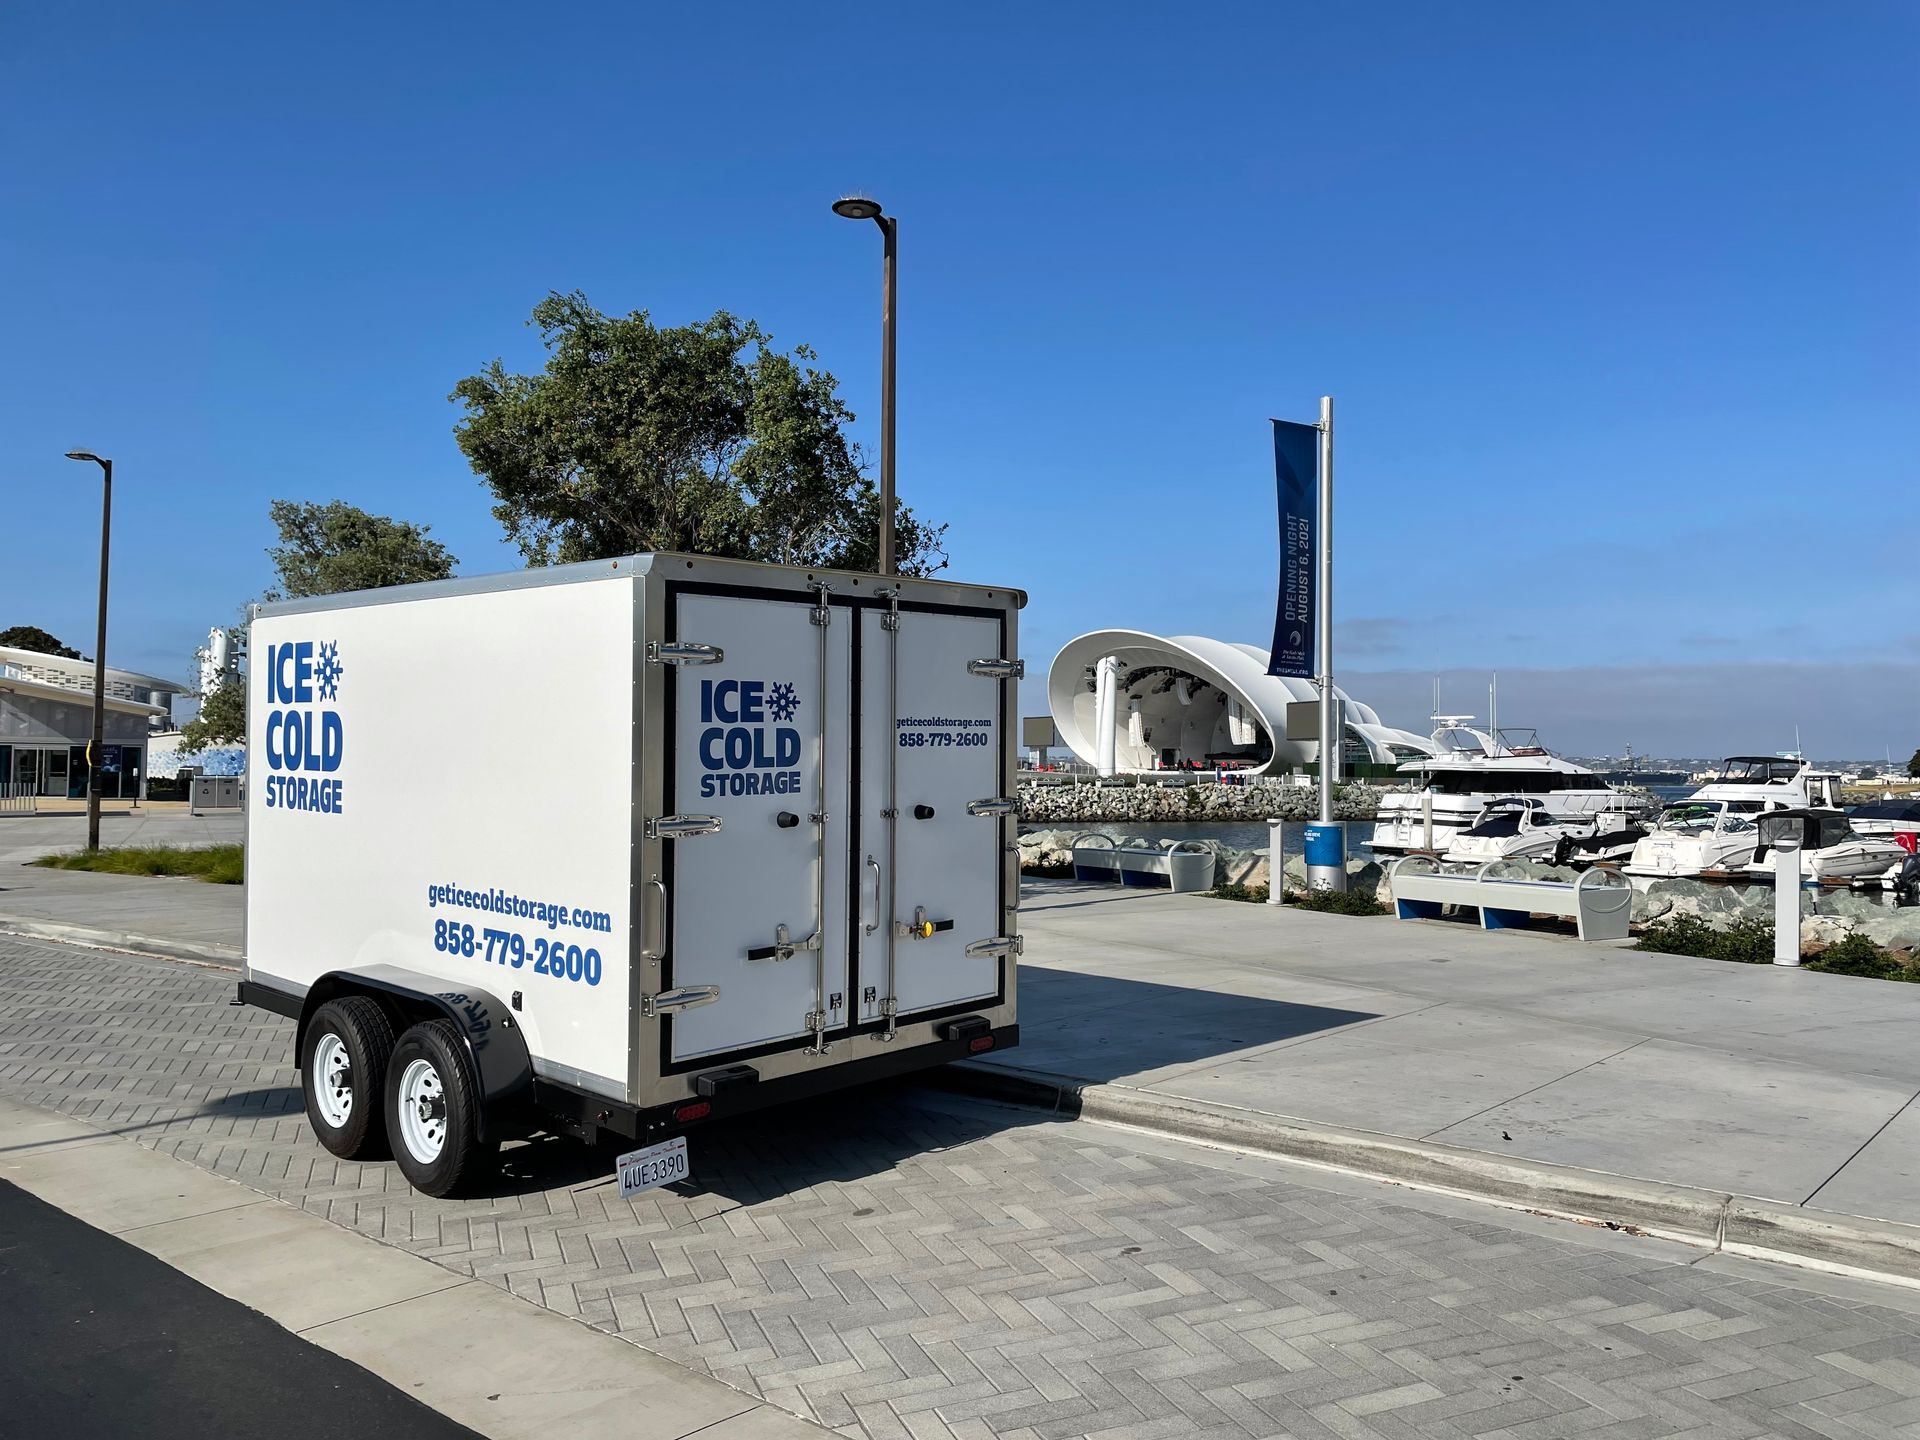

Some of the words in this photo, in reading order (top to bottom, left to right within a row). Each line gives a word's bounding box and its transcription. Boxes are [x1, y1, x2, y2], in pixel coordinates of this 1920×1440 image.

[1287, 512, 1297, 555] NIGHT
[1299, 518, 1309, 549] 2021
[1299, 553, 1310, 566] 6,
[1285, 559, 1297, 621] OPENING
[1298, 567, 1309, 623] AUGUST
[267, 641, 313, 704] ICE
[700, 679, 764, 724] ICE
[896, 716, 992, 729] geticecoldstorage.com
[266, 710, 343, 772] COLD
[699, 727, 802, 771] COLD
[899, 732, 988, 747] 858-779-2600
[266, 774, 343, 814] STORAGE
[700, 771, 801, 798] STORAGE
[428, 882, 612, 933] geticecoldstorage.com
[434, 918, 602, 987] 858-779-2600
[624, 1154, 684, 1190] 4UE3390
